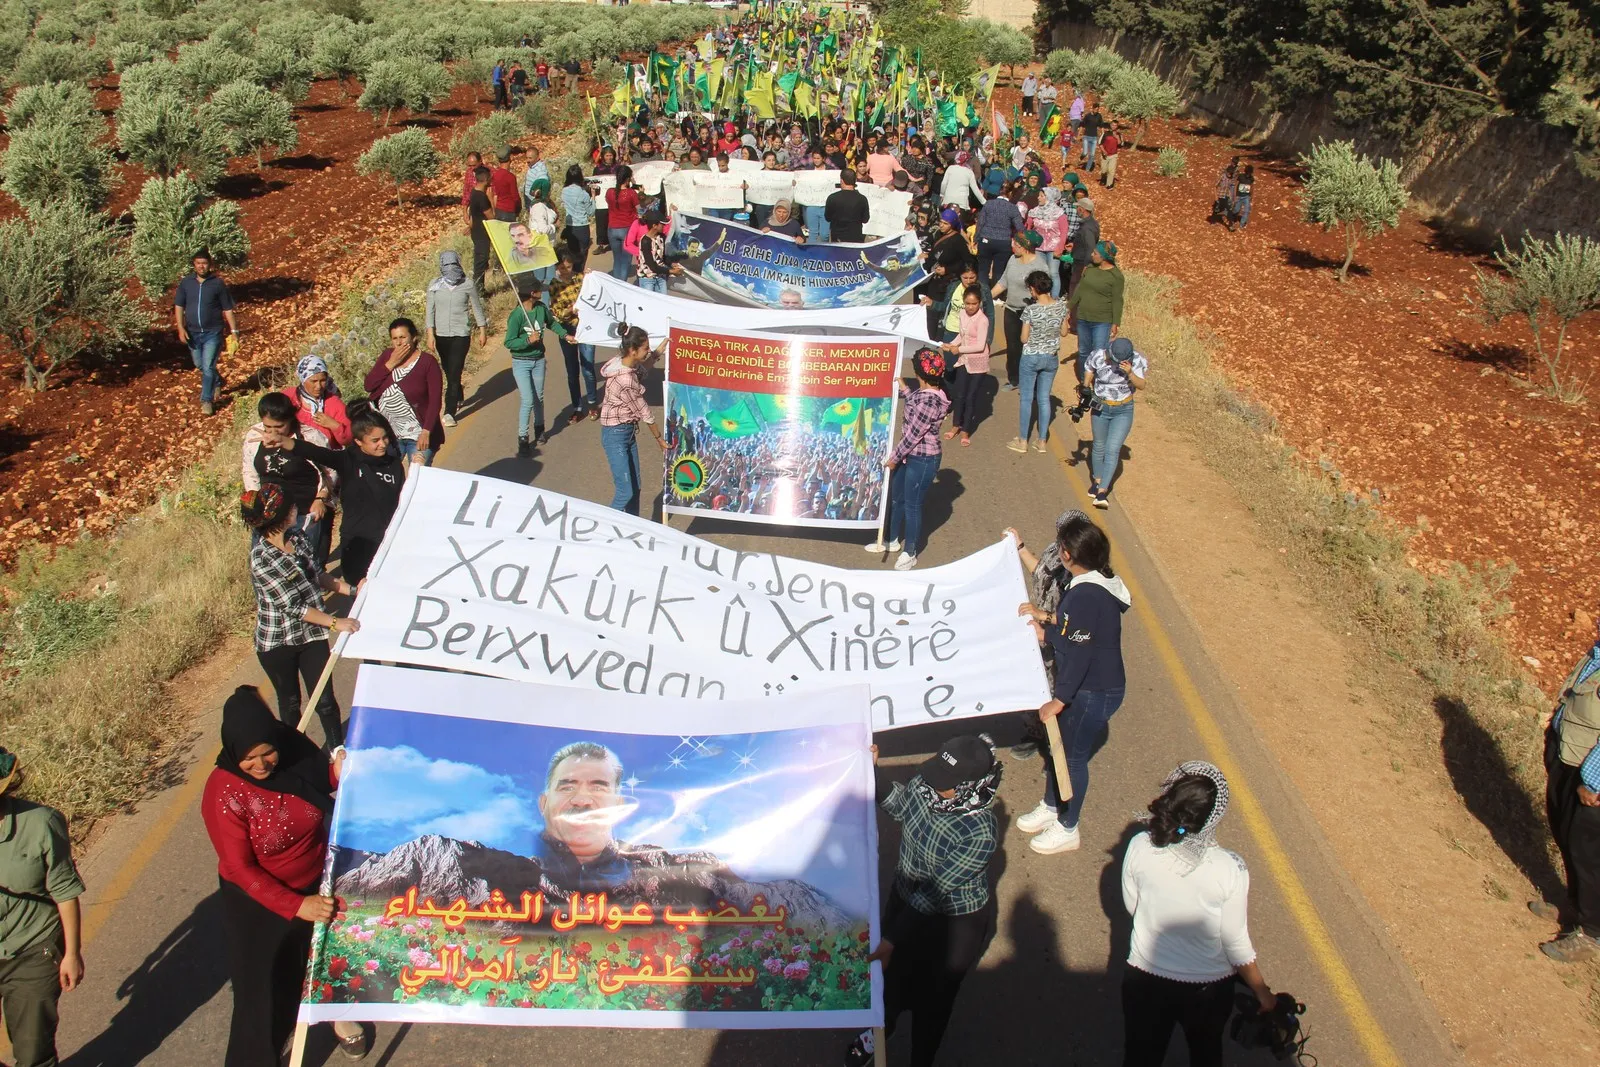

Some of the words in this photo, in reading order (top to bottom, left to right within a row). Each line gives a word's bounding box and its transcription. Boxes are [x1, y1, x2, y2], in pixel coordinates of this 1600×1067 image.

[714, 258, 760, 278] PERGALA
[802, 259, 832, 272] AZAD
[836, 260, 854, 272] EM
[675, 348, 713, 362] ŞINGAL
[726, 355, 774, 368] QENDÎLÊ
[863, 363, 890, 372] DIKE!
[678, 335, 721, 350] ARTEŞA
[724, 341, 749, 353] TIRK
[752, 345, 761, 354] A
[830, 347, 880, 358] MEXMÛR
[686, 363, 695, 373] Li
[717, 367, 764, 381] Qirkirinê
[767, 373, 785, 382] Em
[824, 376, 842, 385] Ser
[845, 376, 877, 387] Piyan!
[453, 480, 502, 528] Li
[420, 535, 695, 642] Xakûrk
[720, 594, 753, 658] û
[766, 600, 959, 671] Xinêrê
[400, 595, 725, 700] Berxwedan
[385, 886, 544, 927] الشهداء
[552, 891, 654, 932] عوائل
[663, 894, 788, 932] بغضب
[529, 948, 580, 993] نار
